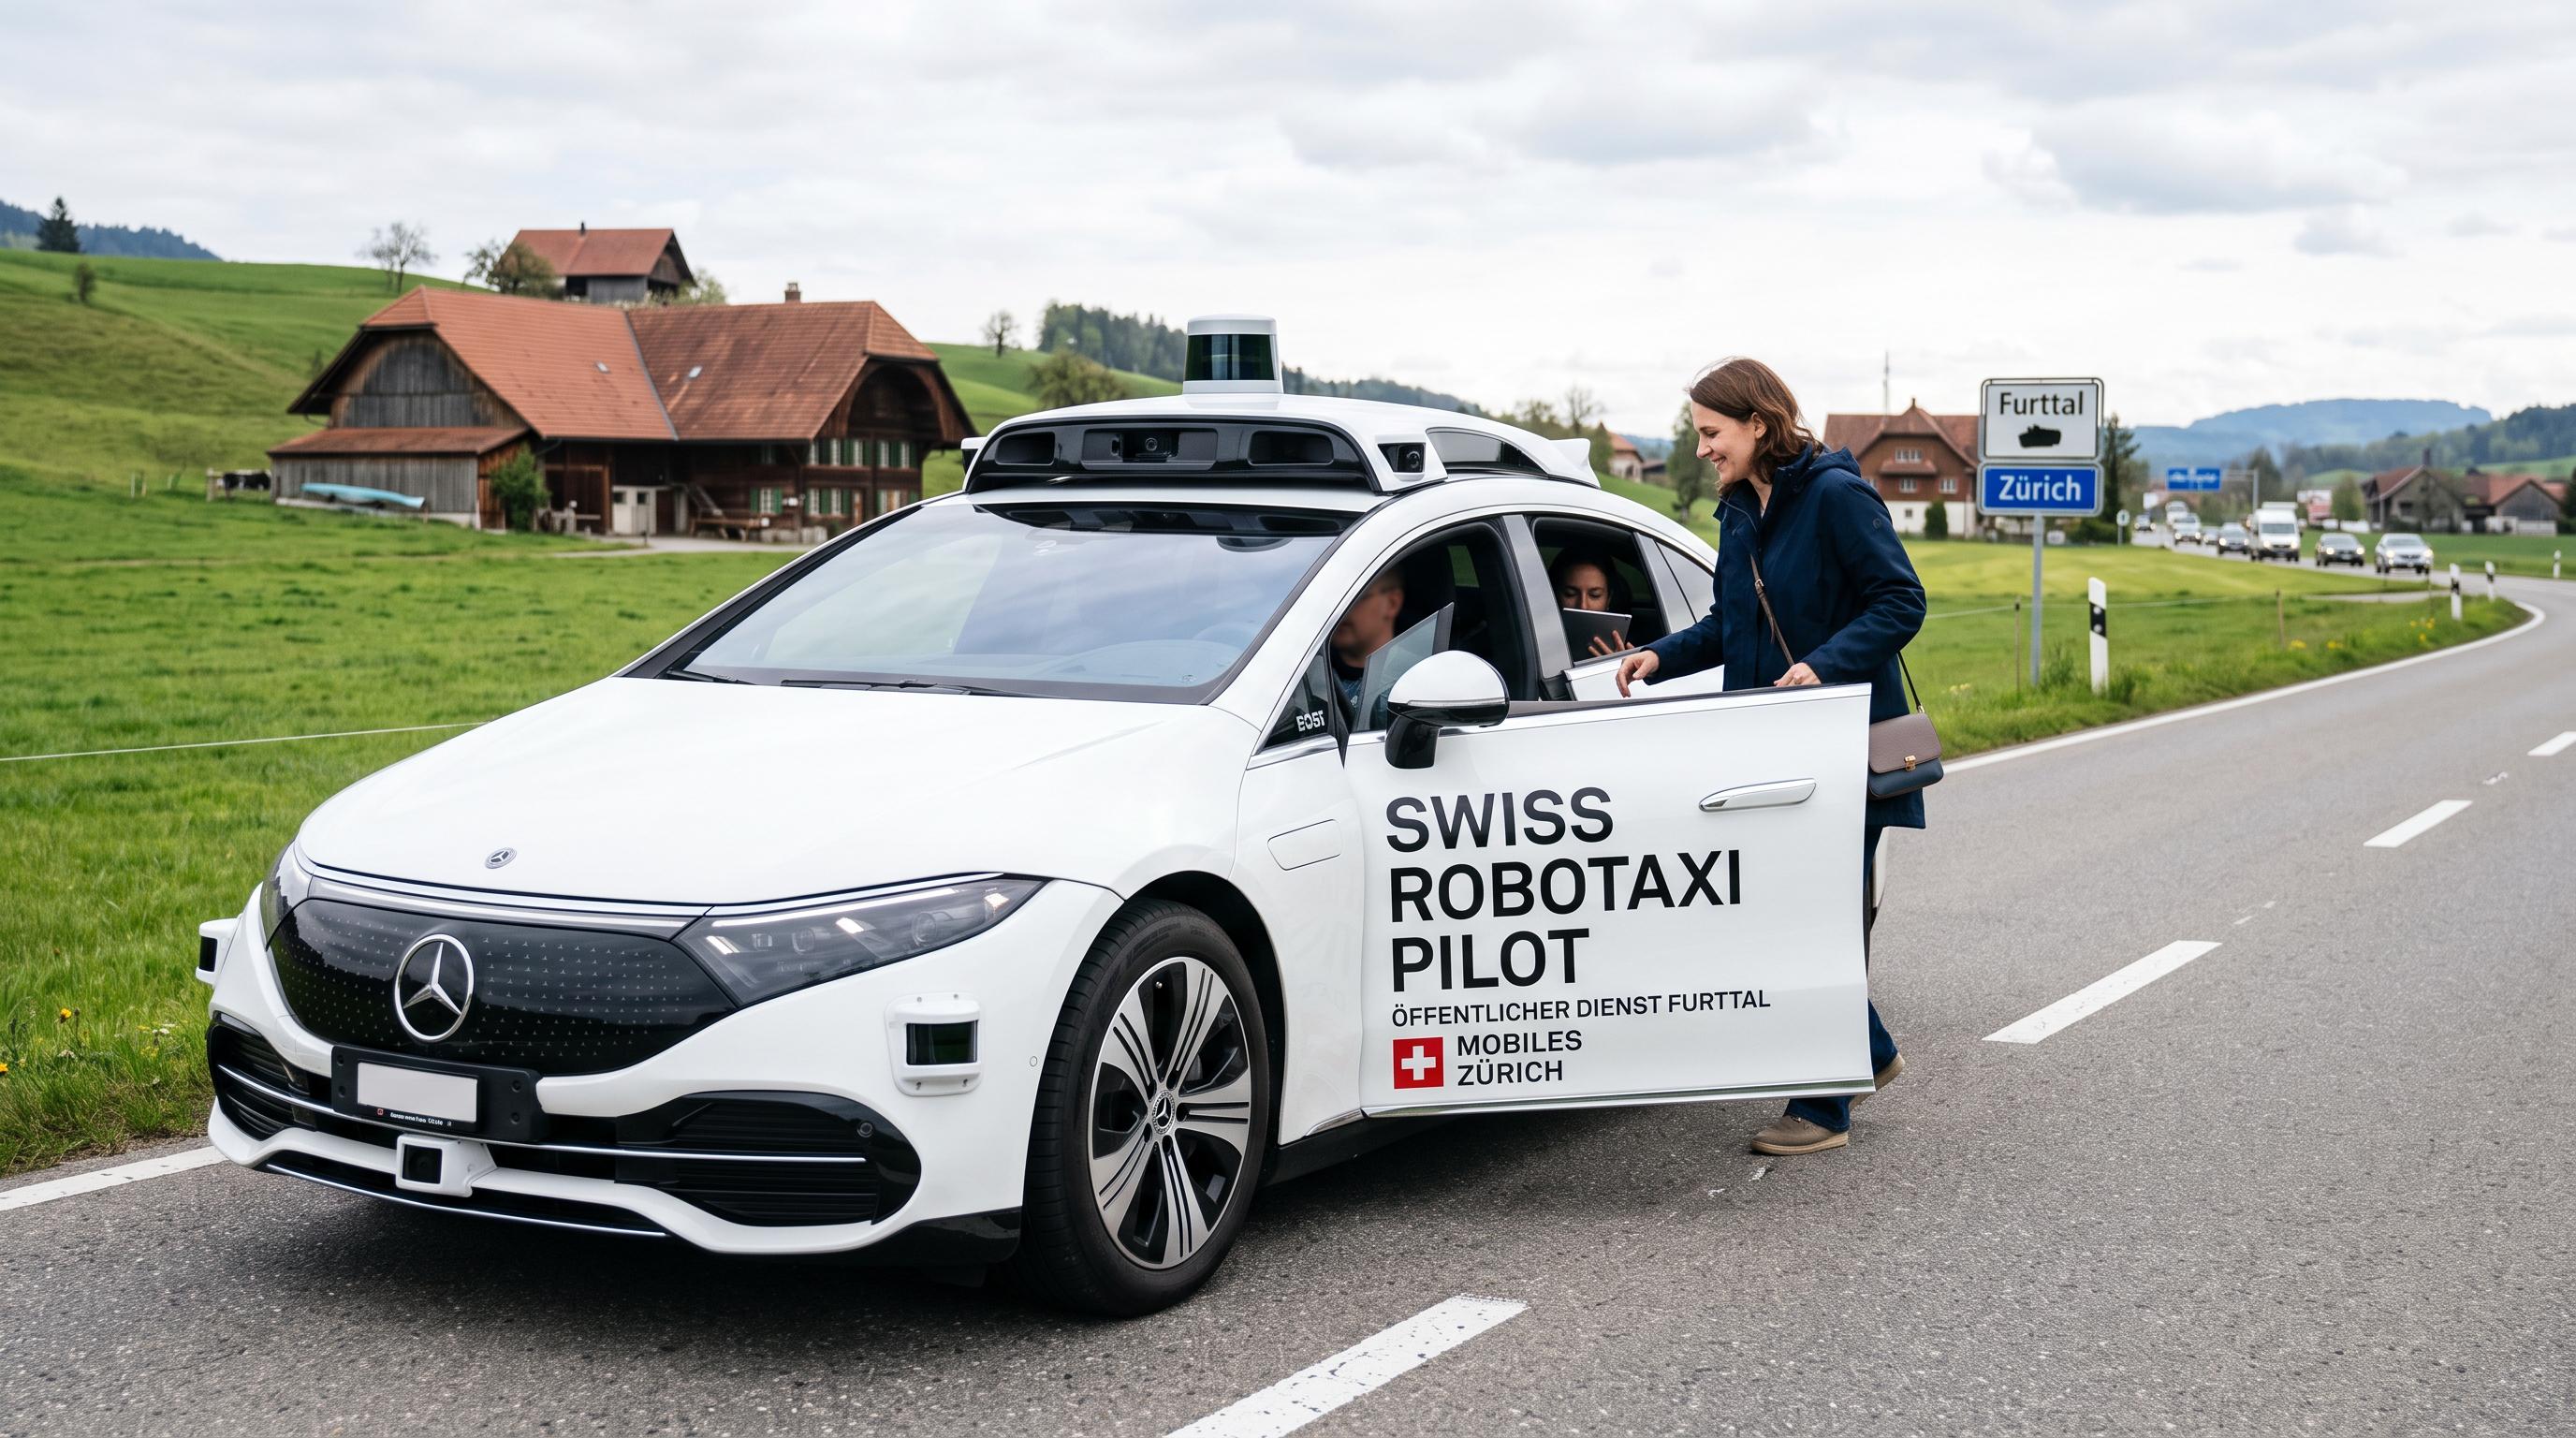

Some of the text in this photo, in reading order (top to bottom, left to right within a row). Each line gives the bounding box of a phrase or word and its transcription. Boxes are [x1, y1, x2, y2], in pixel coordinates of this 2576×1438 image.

[1999, 390, 2084, 416] Furttal
[1998, 474, 2082, 502] Zürich
[1385, 786, 1614, 853] SWISS
[1390, 849, 1742, 923] ROBOTAXI
[1392, 927, 1590, 992] PILOT
[1391, 990, 1771, 1028] ÖFFENTLICHER DIENST FURTTAL
[1456, 1029, 1583, 1057] MOBILES
[1456, 1058, 1563, 1087] ZÜRICH
